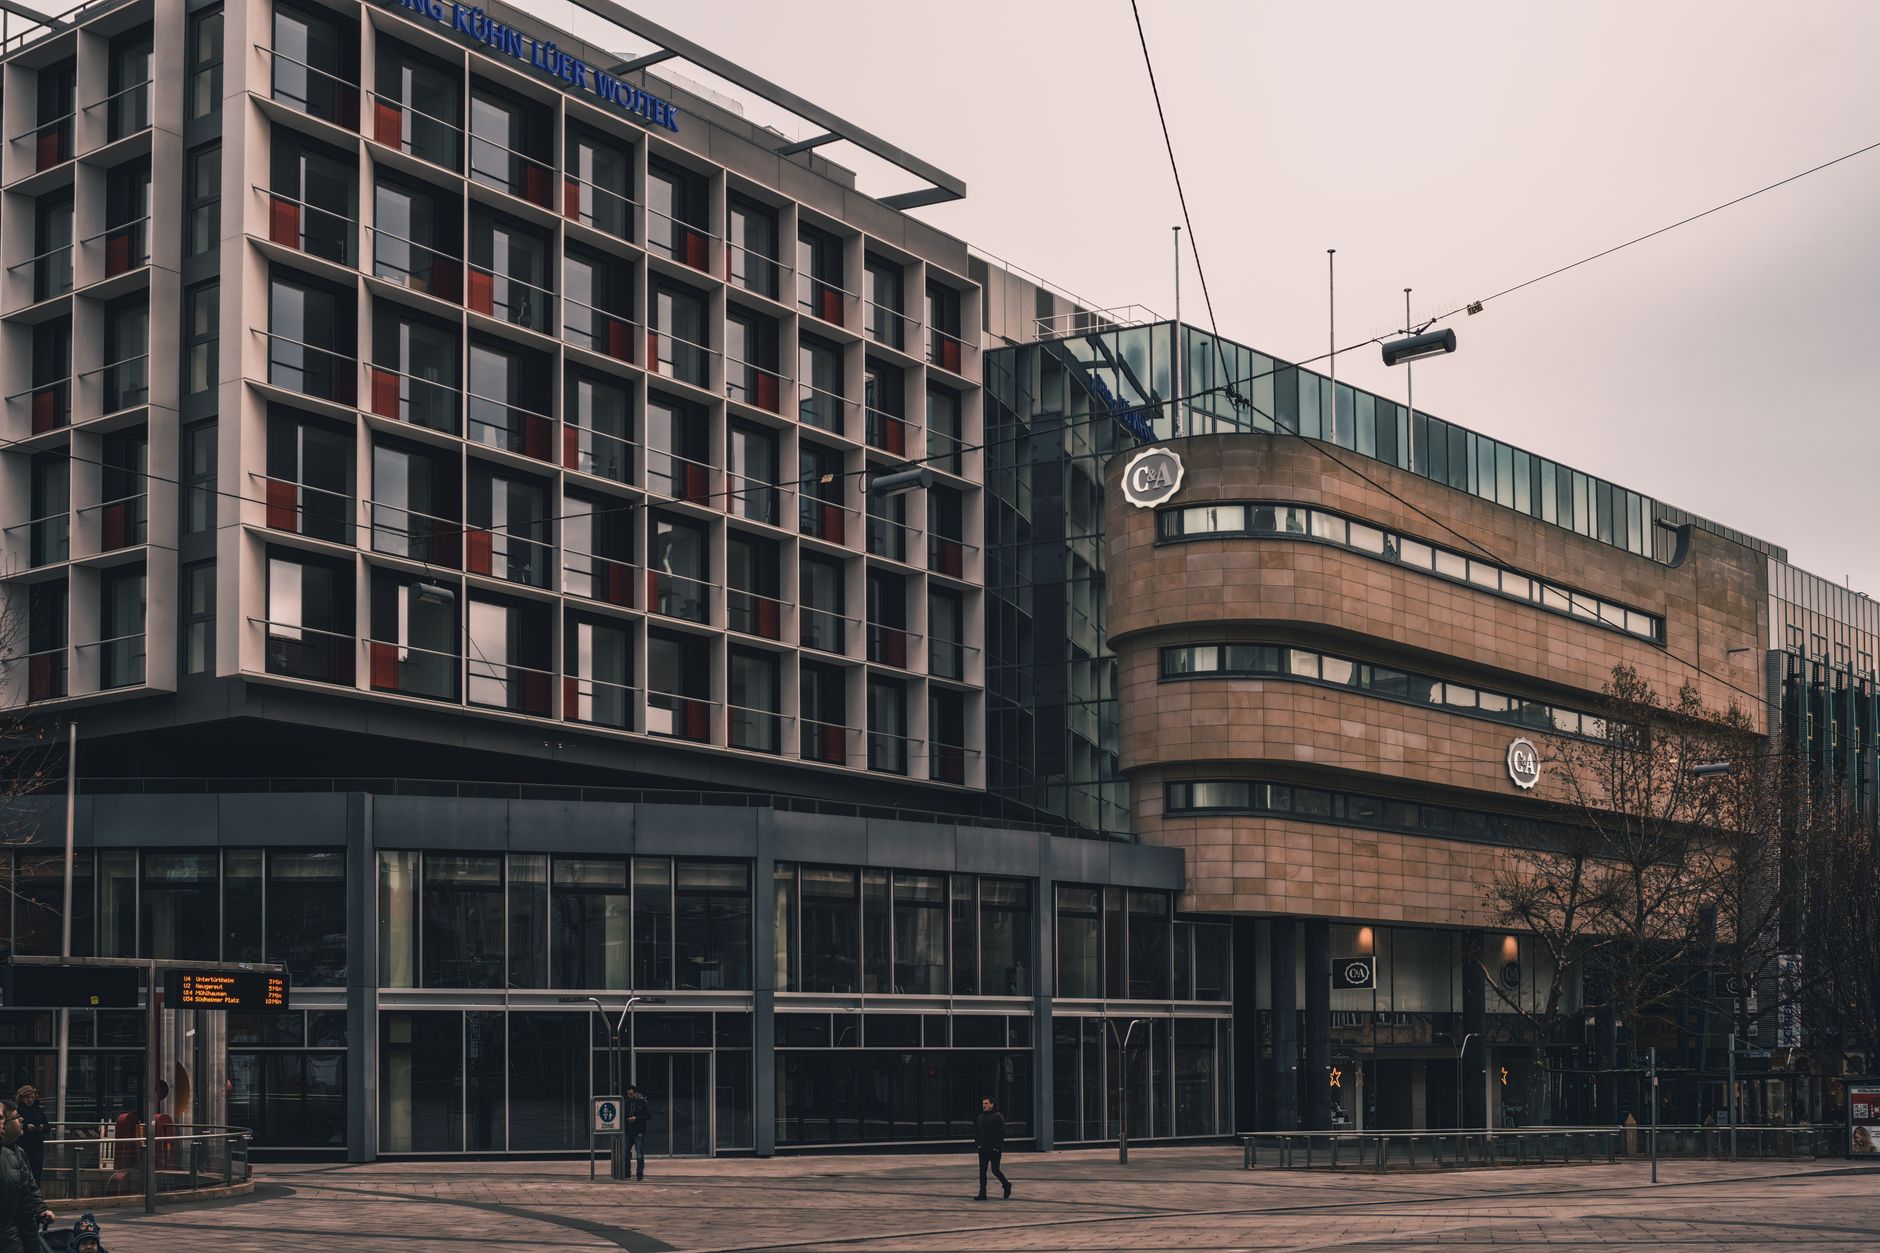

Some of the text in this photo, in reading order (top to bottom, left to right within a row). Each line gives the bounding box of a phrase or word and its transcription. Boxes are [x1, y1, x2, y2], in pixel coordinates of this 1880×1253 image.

[398, 0, 680, 132] NG KÜHN LÜER WOJTEK
[1132, 462, 1172, 492] C&A
[1513, 750, 1536, 775] C&A
